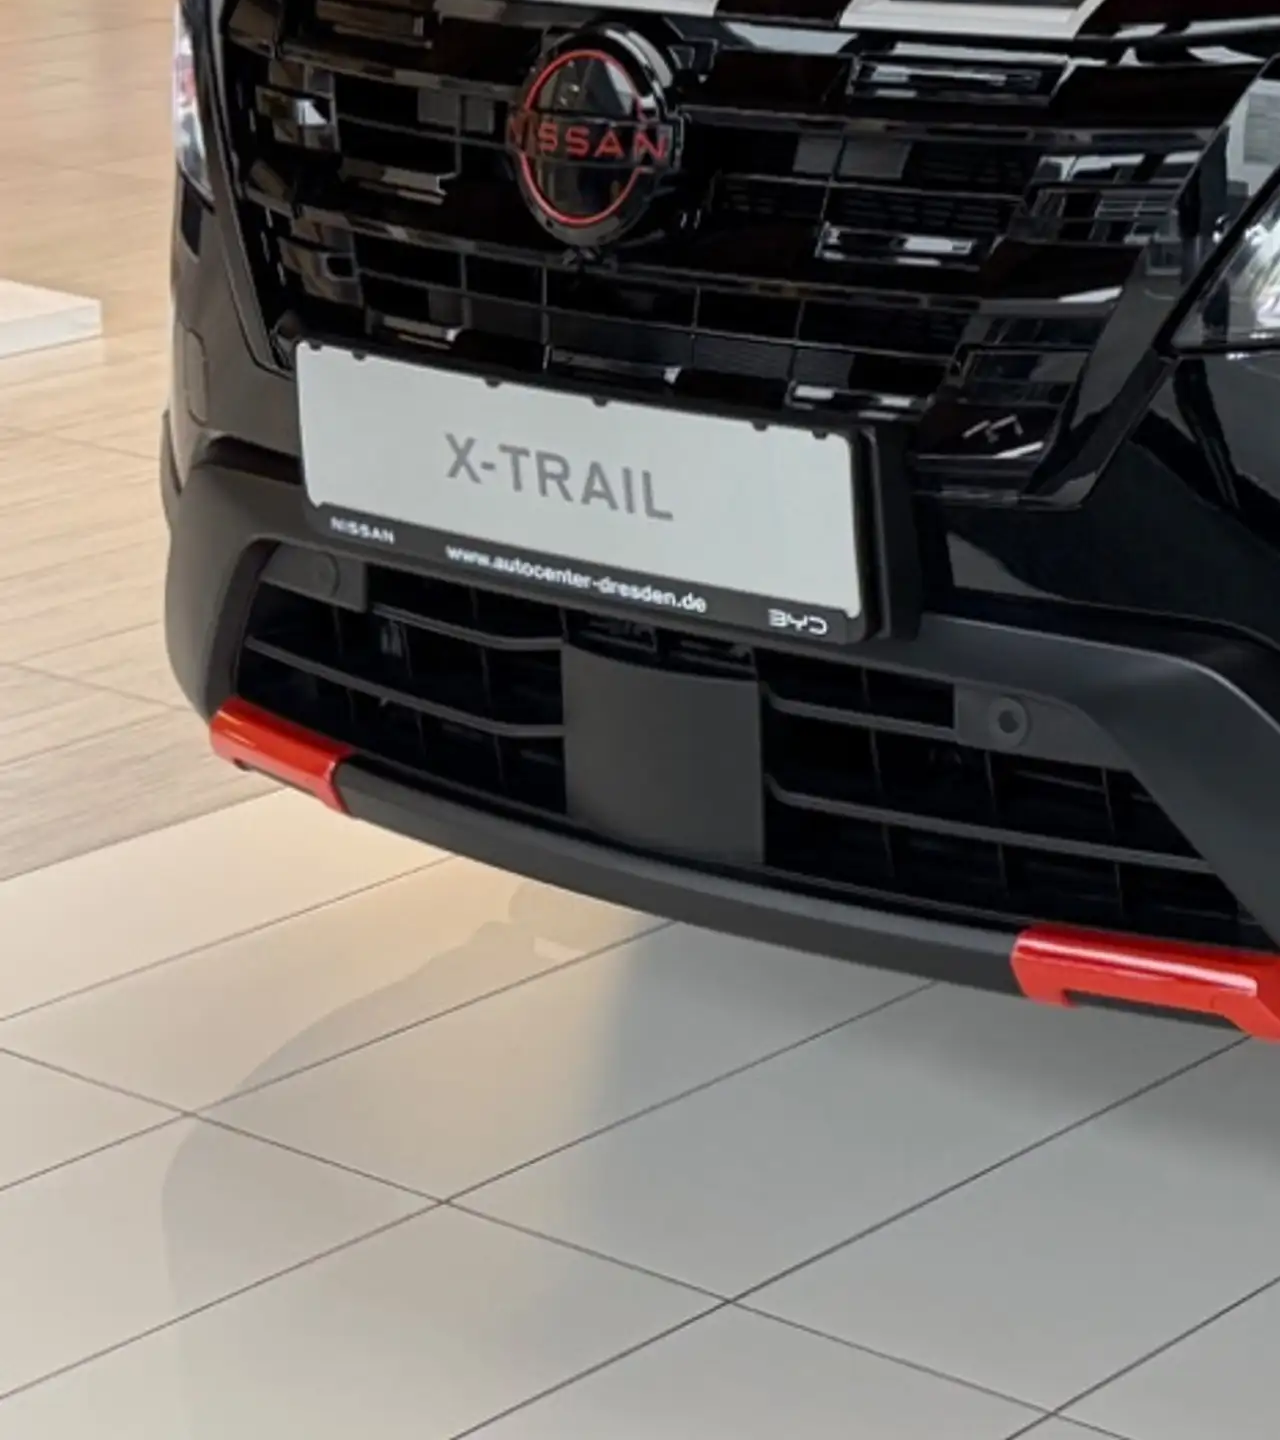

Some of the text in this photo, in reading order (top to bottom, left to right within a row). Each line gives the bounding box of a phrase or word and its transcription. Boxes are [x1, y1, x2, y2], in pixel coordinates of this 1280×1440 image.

[445, 432, 674, 522] X-TRAIL
[329, 515, 395, 545] NISSAN
[445, 544, 708, 614] www.autocenter-dresden.de
[767, 608, 827, 636] BYD
